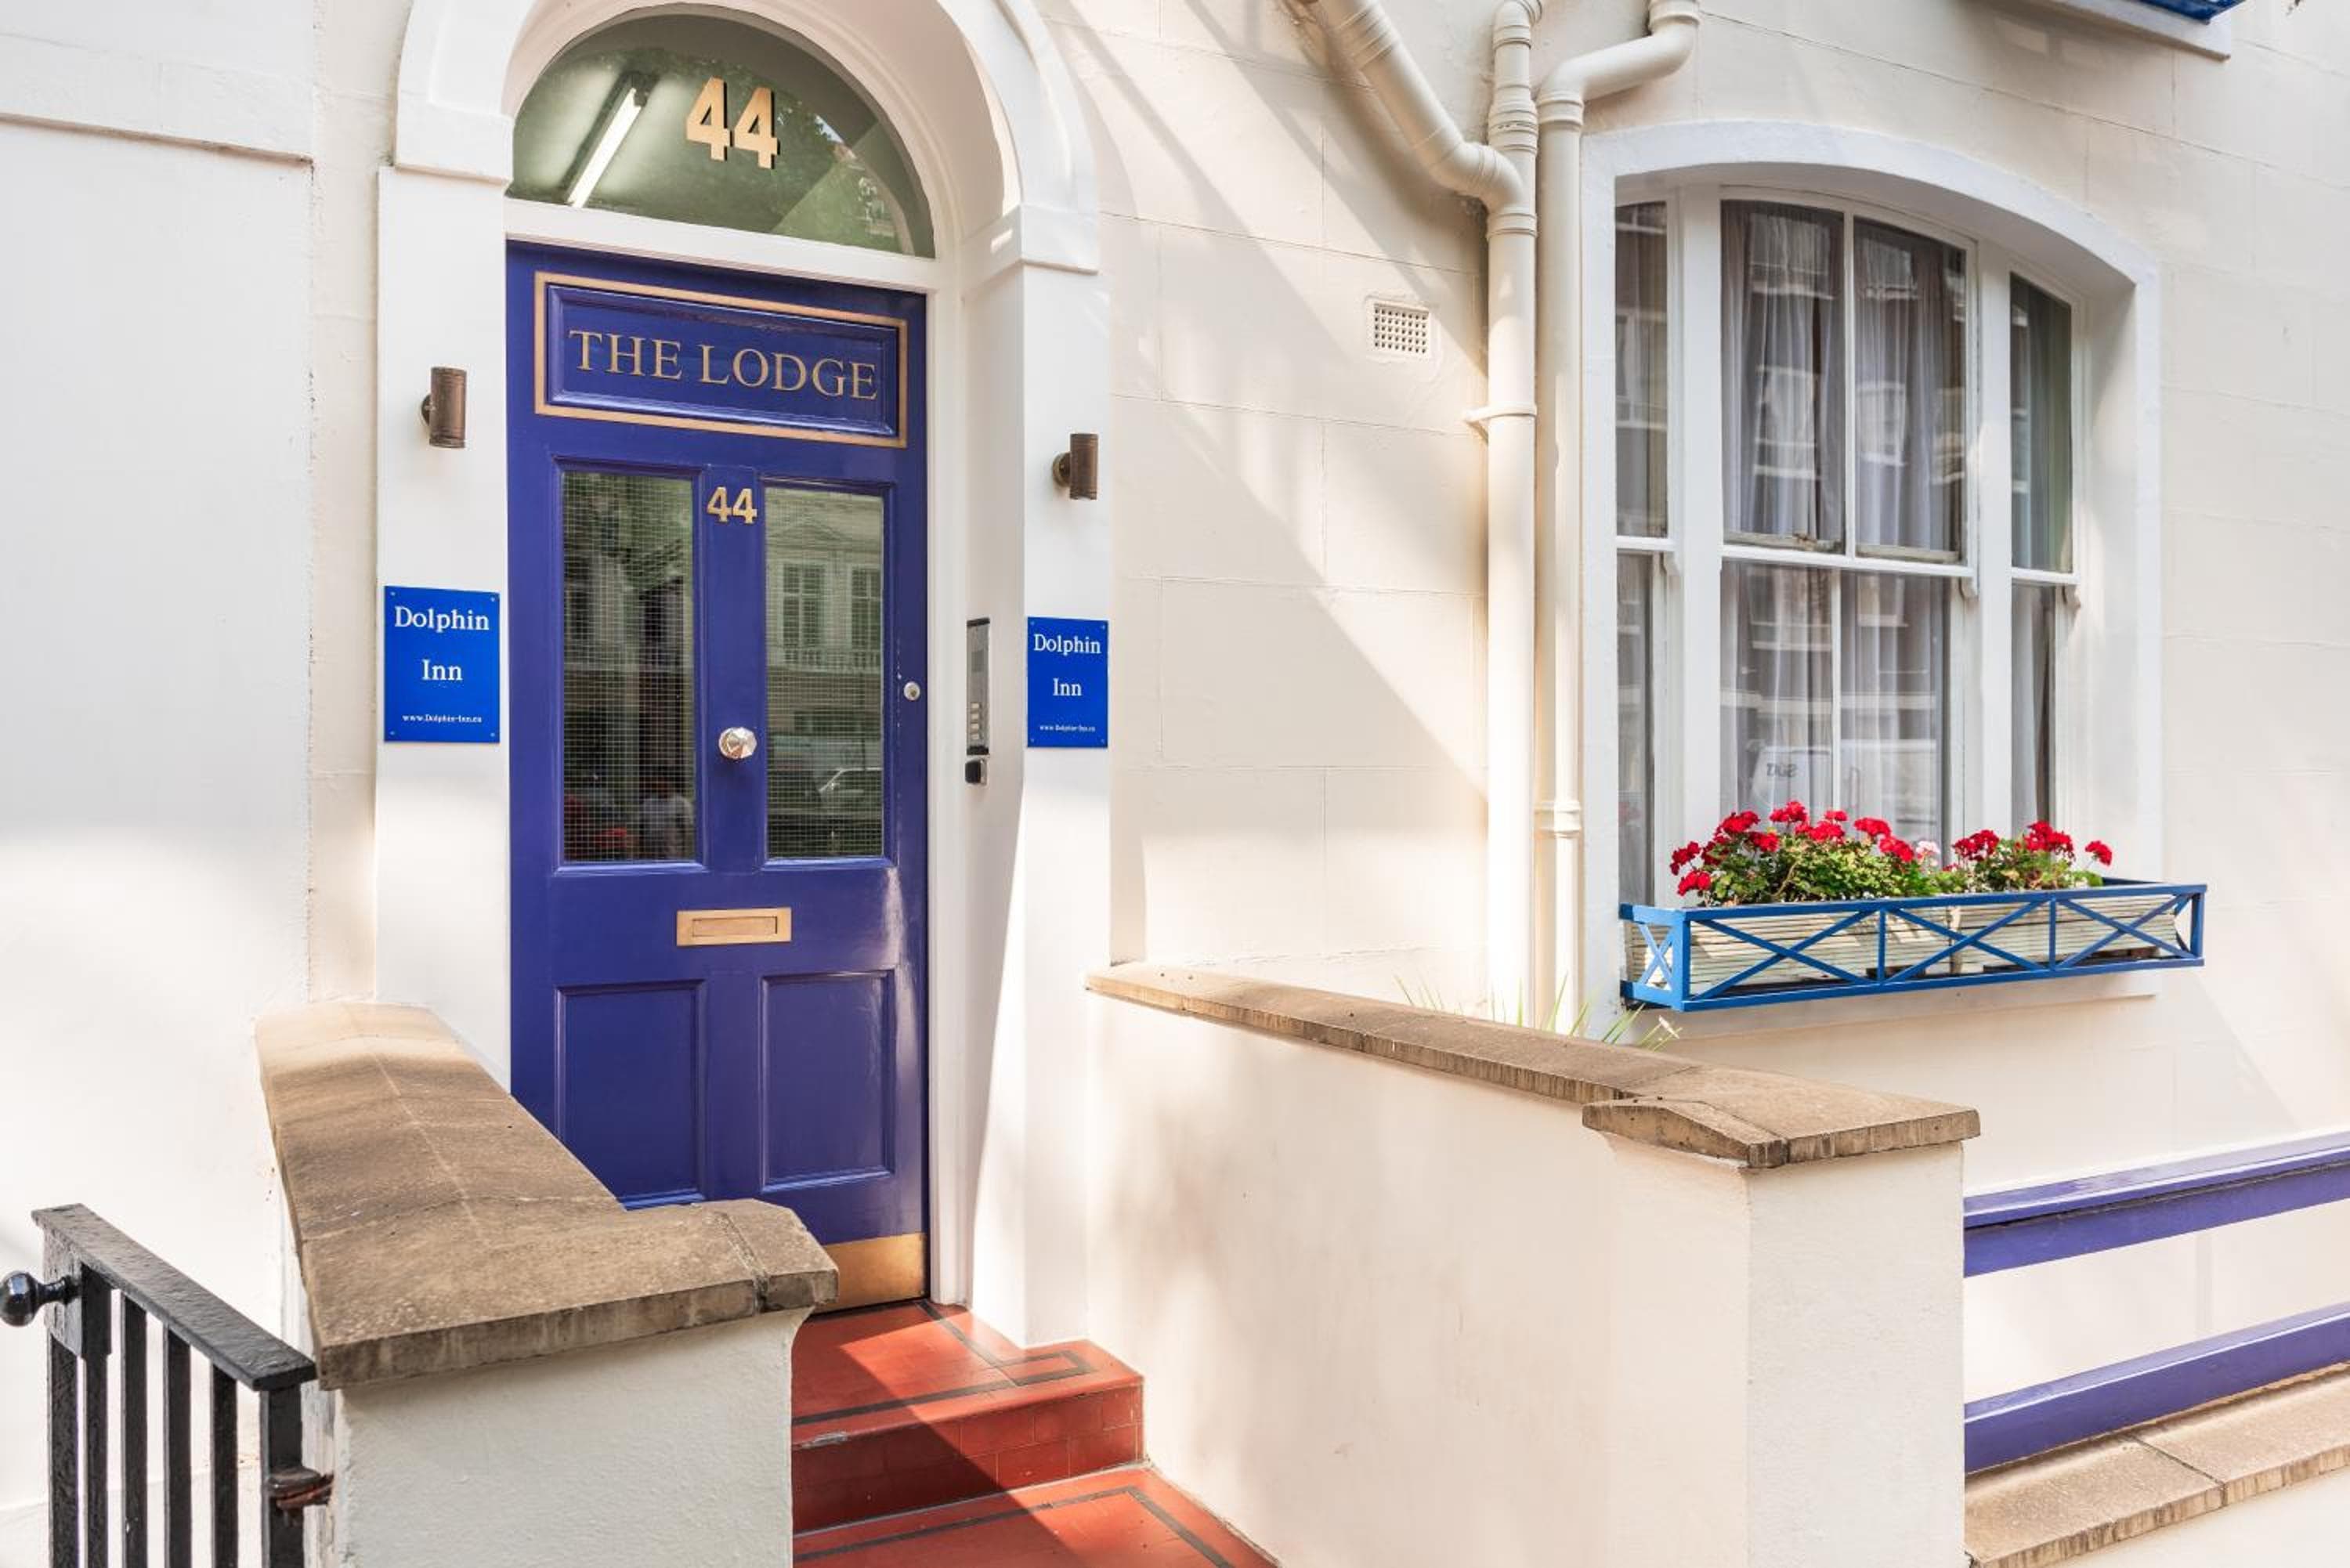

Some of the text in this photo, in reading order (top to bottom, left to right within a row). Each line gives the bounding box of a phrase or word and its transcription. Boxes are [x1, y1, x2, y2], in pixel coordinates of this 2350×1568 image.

[686, 77, 777, 169] 44
[569, 330, 878, 400] THE LODGE
[707, 486, 757, 523] 44
[394, 605, 490, 632] Dolphin
[1033, 633, 1101, 656] Dolphin
[421, 659, 463, 681] Inn
[1053, 677, 1083, 696] Inn
